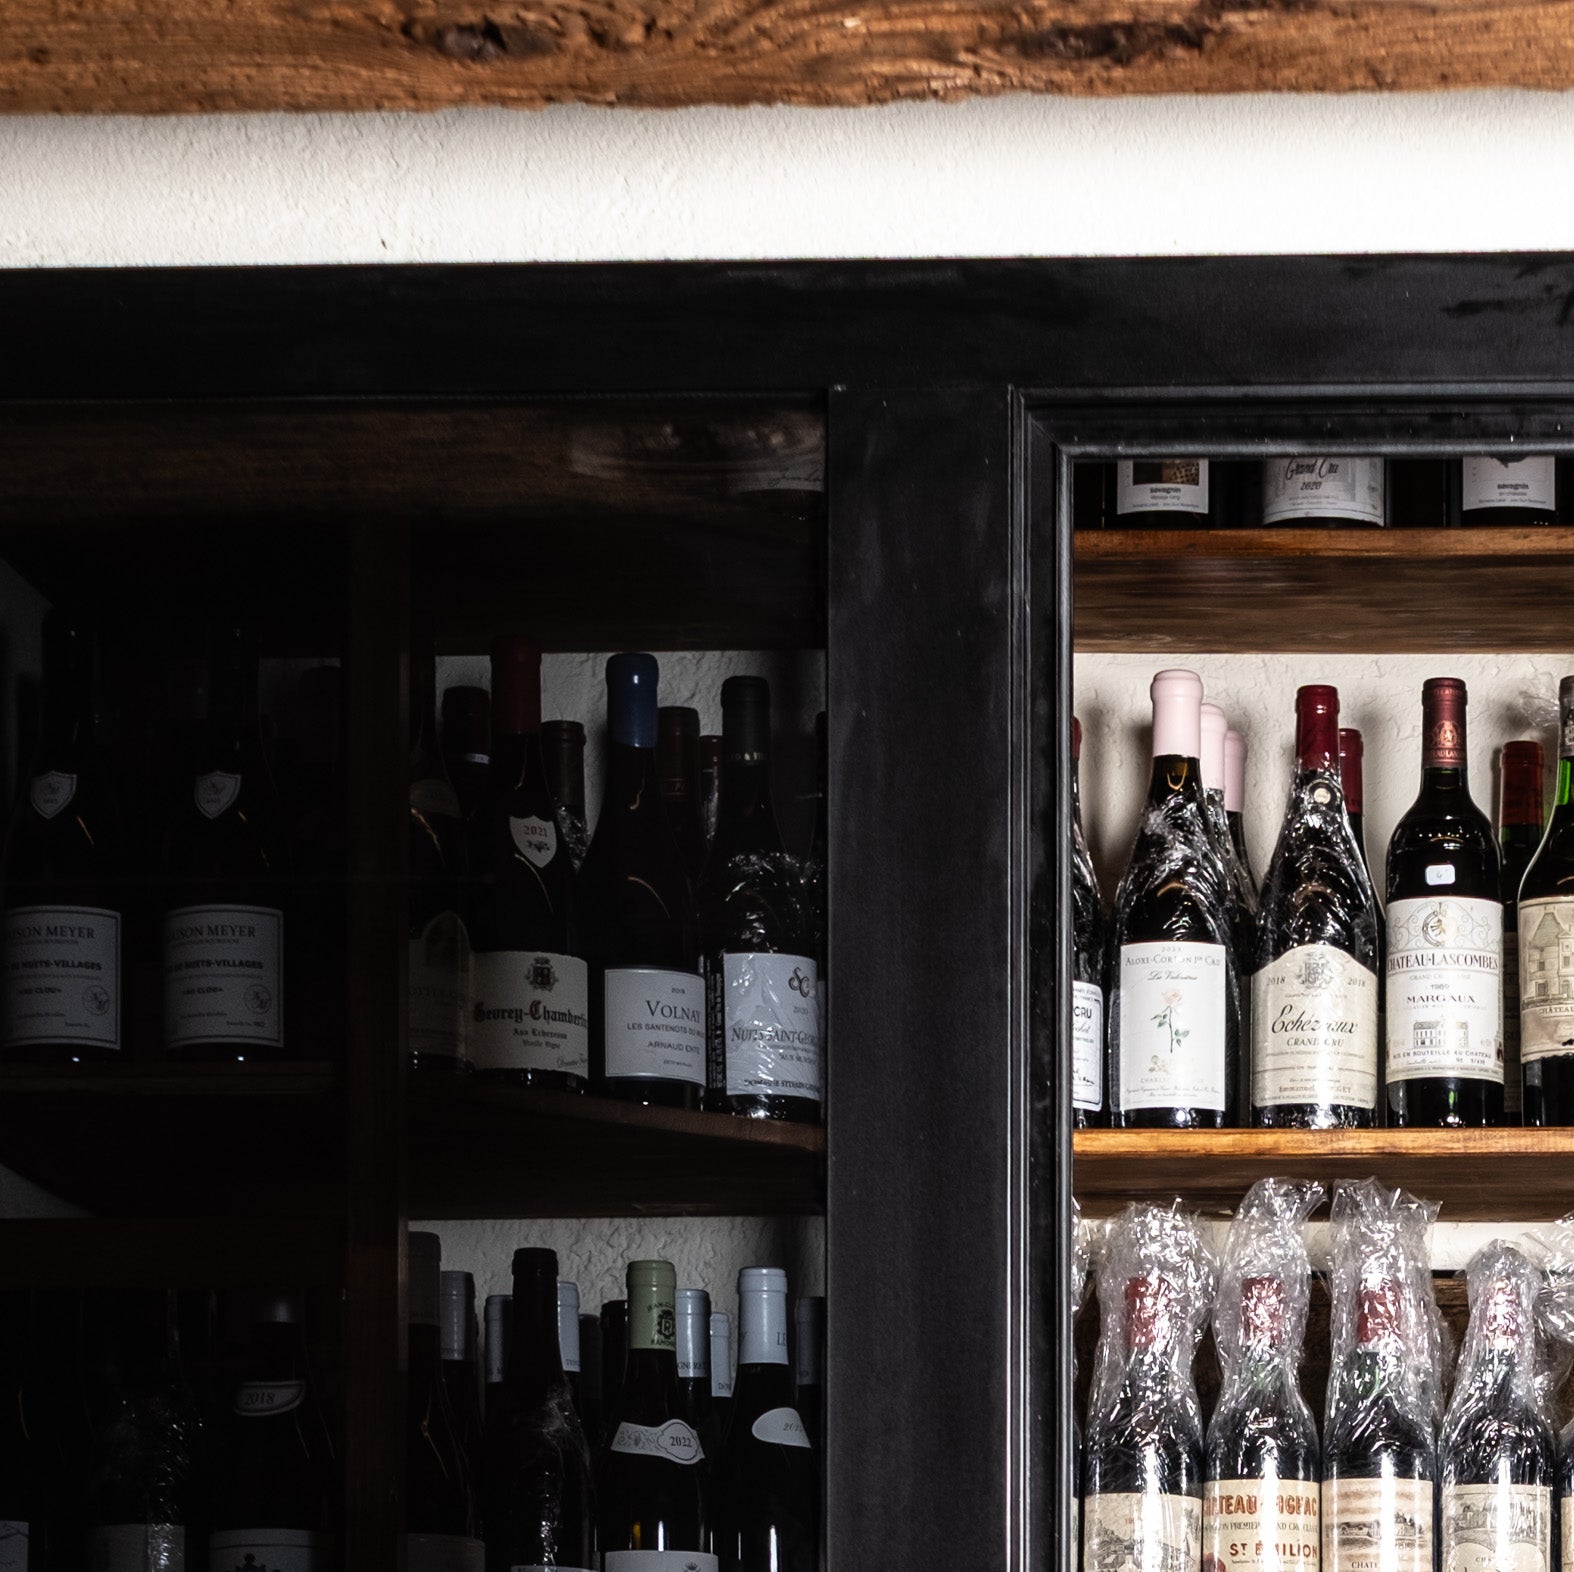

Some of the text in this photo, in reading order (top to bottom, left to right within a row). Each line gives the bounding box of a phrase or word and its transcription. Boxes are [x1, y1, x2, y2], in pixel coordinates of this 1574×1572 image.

[524, 825, 548, 838] 2021
[45, 926, 95, 939] MEYER
[208, 925, 256, 937] MEYER
[1266, 977, 1285, 986] 2018
[1348, 978, 1366, 987] 2018
[670, 1436, 692, 1448] 2022
